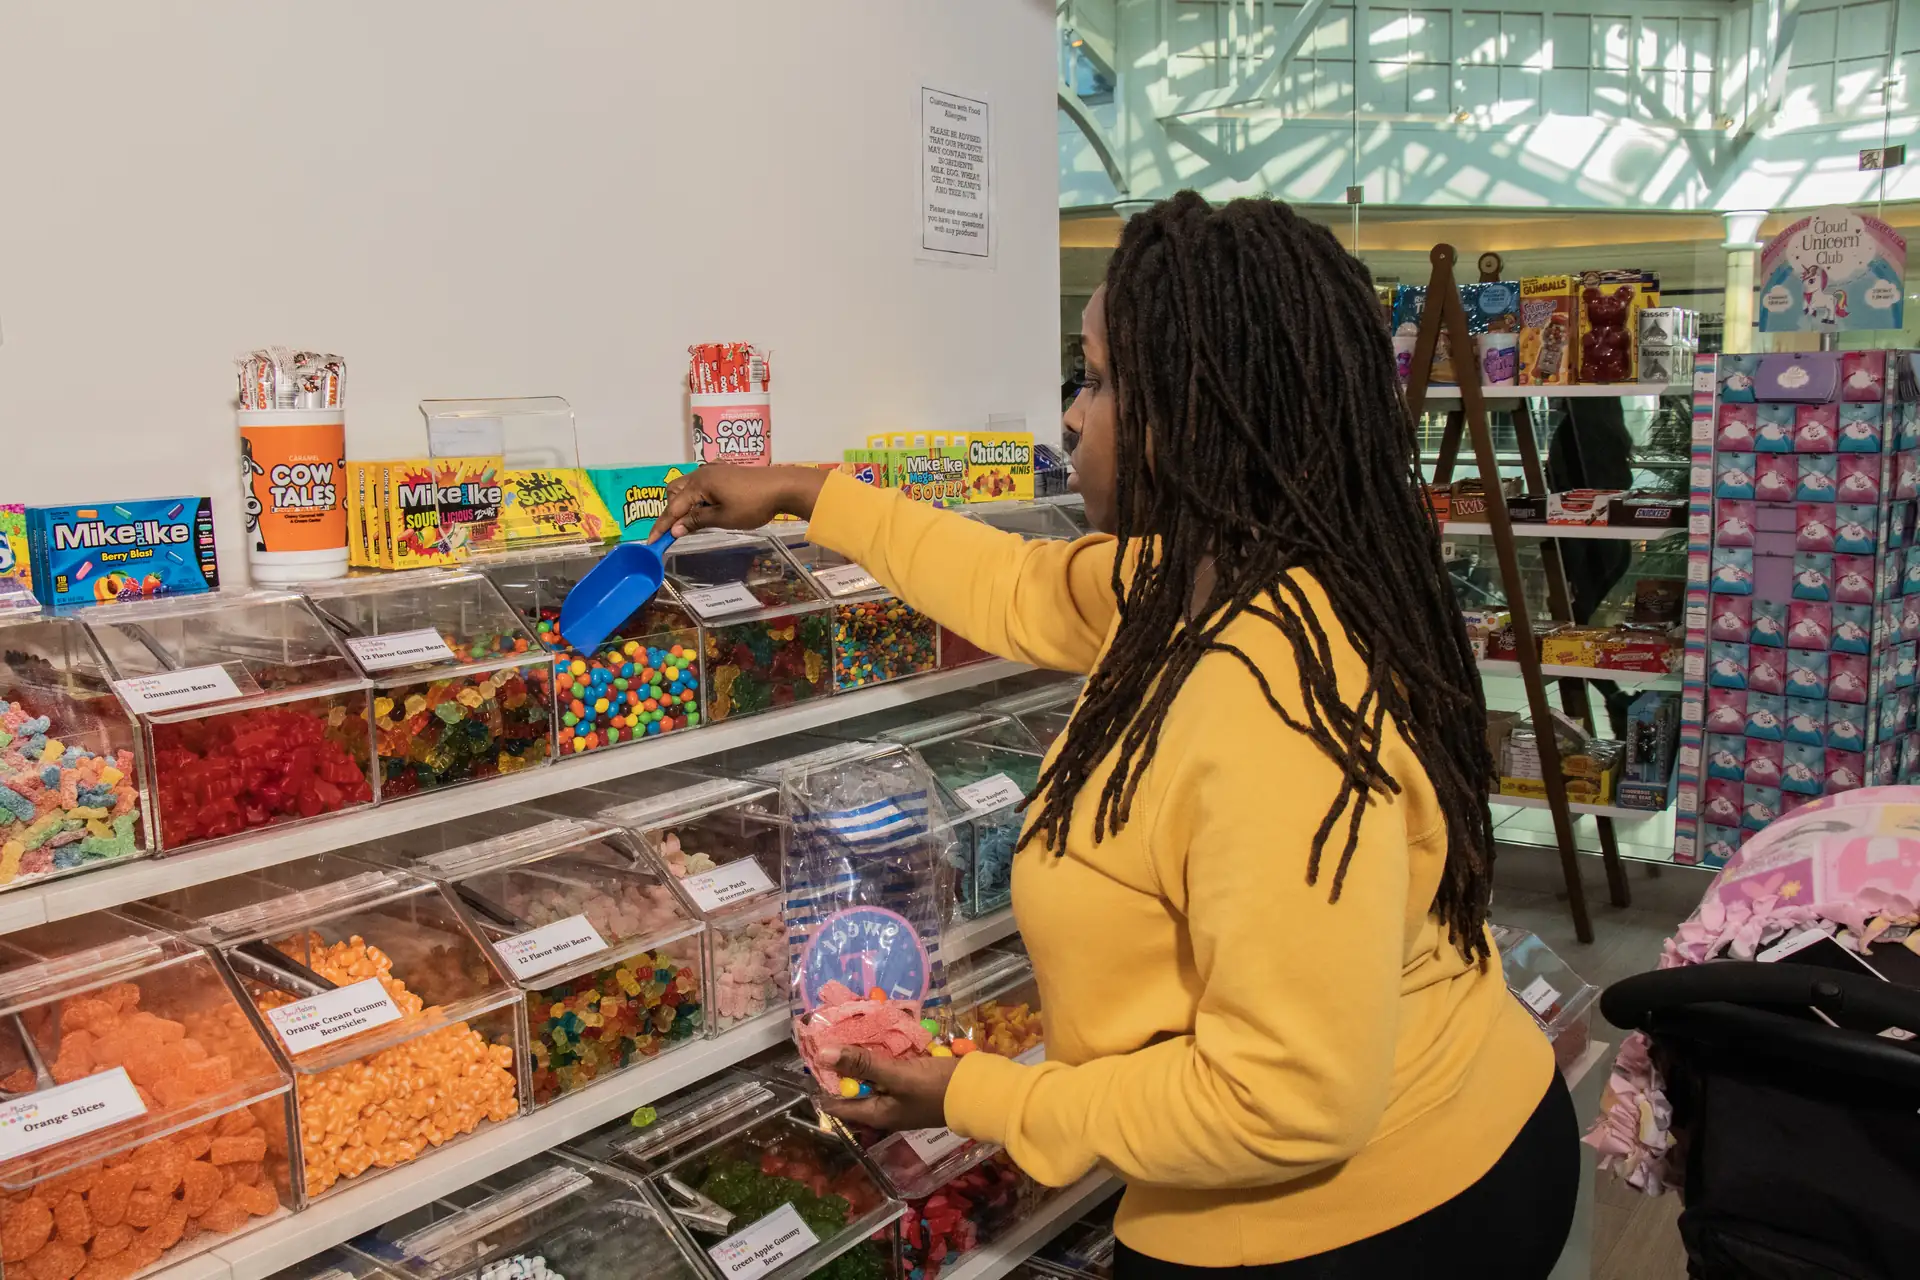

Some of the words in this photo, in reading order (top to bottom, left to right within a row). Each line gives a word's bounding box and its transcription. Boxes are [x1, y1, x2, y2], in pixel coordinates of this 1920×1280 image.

[930, 96, 956, 110] Customers
[968, 106, 981, 116] Food
[944, 109, 967, 122] Allergies
[930, 126, 950, 136] PLEASE
[950, 130, 958, 138] BE
[929, 136, 944, 145] THAT
[945, 139, 956, 148] OUR
[928, 144, 940, 154] MAY
[942, 148, 966, 158] CONTAIN
[935, 186, 948, 195] AND
[1814, 218, 1848, 234] Cloud
[1802, 235, 1860, 251] Unicorn
[1816, 252, 1844, 265] Club
[1524, 280, 1567, 295] GUMBALLS
[716, 419, 764, 438] COW
[716, 436, 765, 454] TALES
[906, 456, 940, 473] Mike
[944, 456, 962, 472] Ike
[1010, 465, 1030, 475] MINIS
[270, 463, 333, 487] COW
[910, 472, 934, 484] Mega
[269, 484, 336, 507] TALES
[398, 484, 462, 508] Mike
[468, 483, 502, 505] Ike
[517, 484, 570, 506] SOUR
[626, 486, 666, 502] chewy
[912, 480, 961, 500] SOUR!
[1636, 508, 1670, 518] SNICKERS
[54, 520, 136, 550] Mike
[136, 522, 144, 546] and
[144, 520, 190, 546] Ike
[101, 552, 128, 562] Berry
[130, 548, 154, 558] Blast
[372, 652, 396, 660] Flavor
[396, 648, 424, 656] Gummy
[143, 688, 190, 700] Cinnamon
[191, 683, 217, 691] Bears
[986, 788, 1009, 800] Raspberry
[714, 884, 730, 896] Sour
[730, 880, 747, 890] Patch
[718, 886, 756, 902] Watermelon
[529, 949, 553, 961] Flavor
[553, 943, 571, 952] Mini
[572, 935, 592, 946] Bears
[286, 1021, 320, 1036] Orange
[322, 1011, 352, 1025] Cream
[353, 999, 388, 1014] Gummy
[320, 1017, 367, 1037] Bearsicles
[24, 1112, 69, 1132] Orange
[71, 1101, 106, 1117] Slices
[926, 1130, 949, 1144] Gummy
[732, 1256, 754, 1272] Green
[754, 1244, 775, 1258] Apple
[773, 1227, 800, 1246] Gummy
[762, 1250, 784, 1266] Bears
